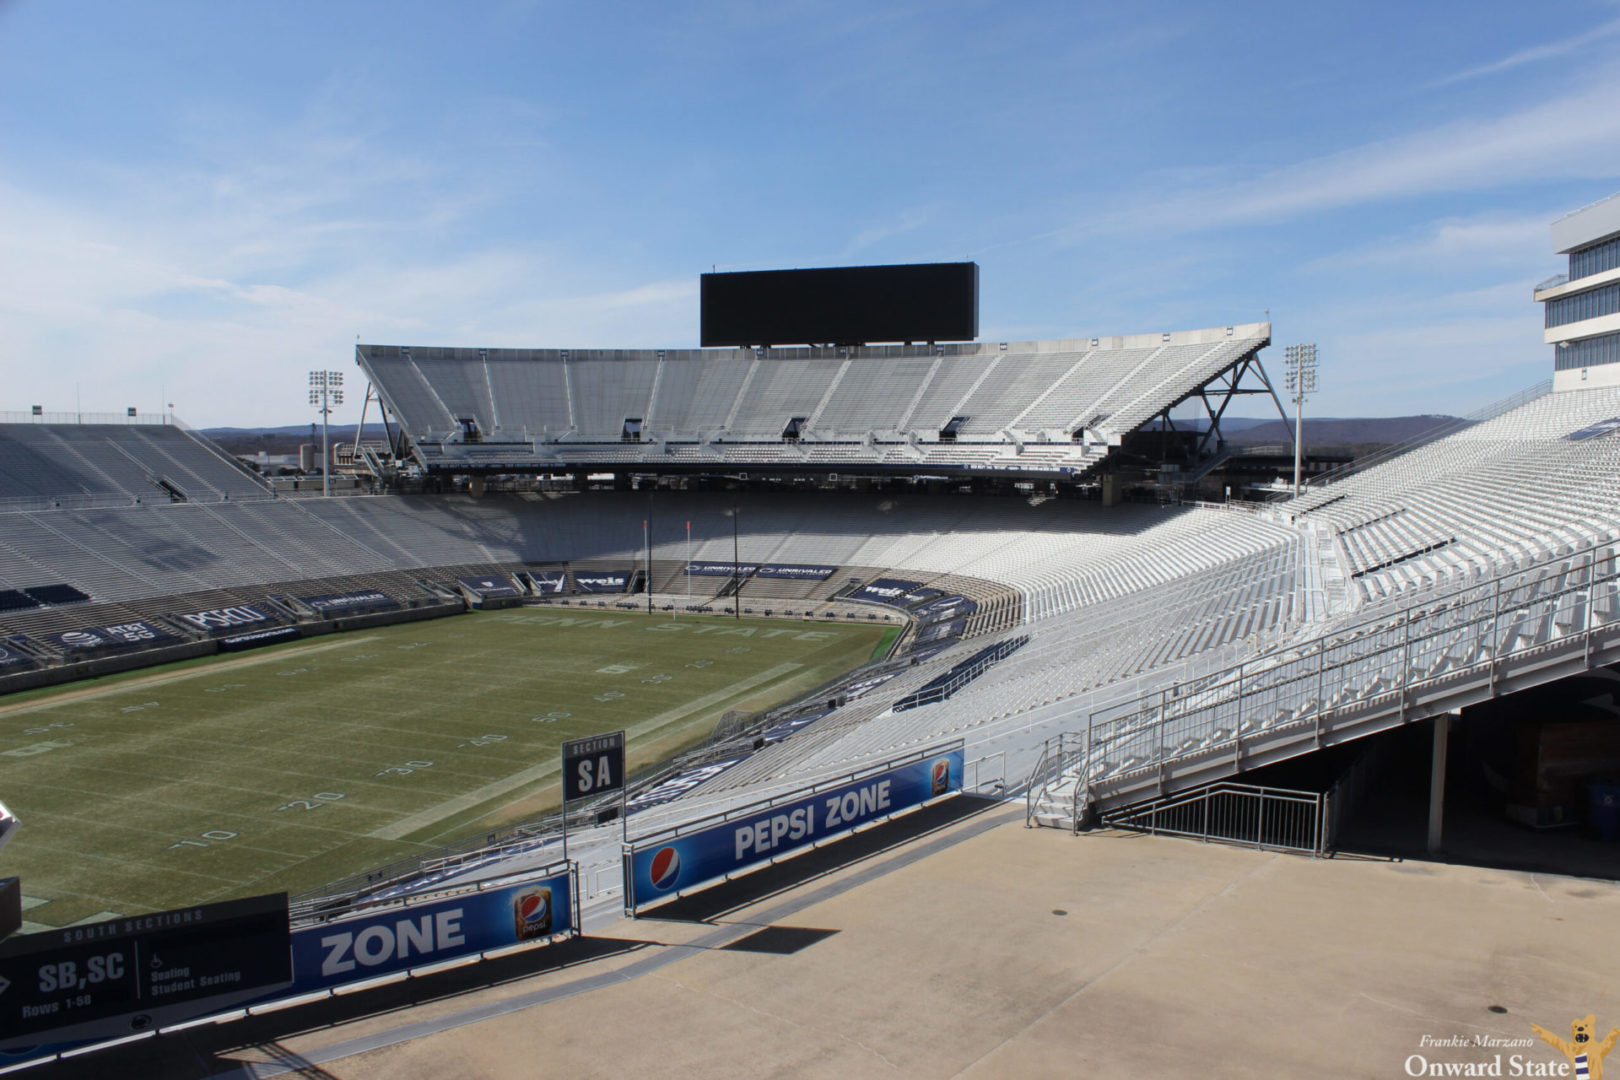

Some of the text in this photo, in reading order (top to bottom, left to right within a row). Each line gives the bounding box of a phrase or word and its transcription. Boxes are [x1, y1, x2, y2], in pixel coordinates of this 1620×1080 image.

[183, 605, 266, 630] PSECU
[105, 622, 147, 635] AT&T
[122, 630, 156, 642] 5G
[646, 623, 839, 642] STATE
[573, 737, 616, 755] SECTION
[385, 760, 434, 775] 30
[577, 755, 611, 792] SA
[287, 792, 345, 810] 20
[735, 780, 891, 860] PEPSI ZONE
[180, 830, 238, 847] 10
[64, 909, 203, 943] SOUTH SECTIONS
[522, 922, 546, 934] pepsi
[321, 907, 466, 977] ZONE
[38, 952, 125, 993] SB,SC
[151, 967, 190, 982] Seating
[151, 971, 241, 996] Student Seating
[22, 1001, 59, 1018] Rows
